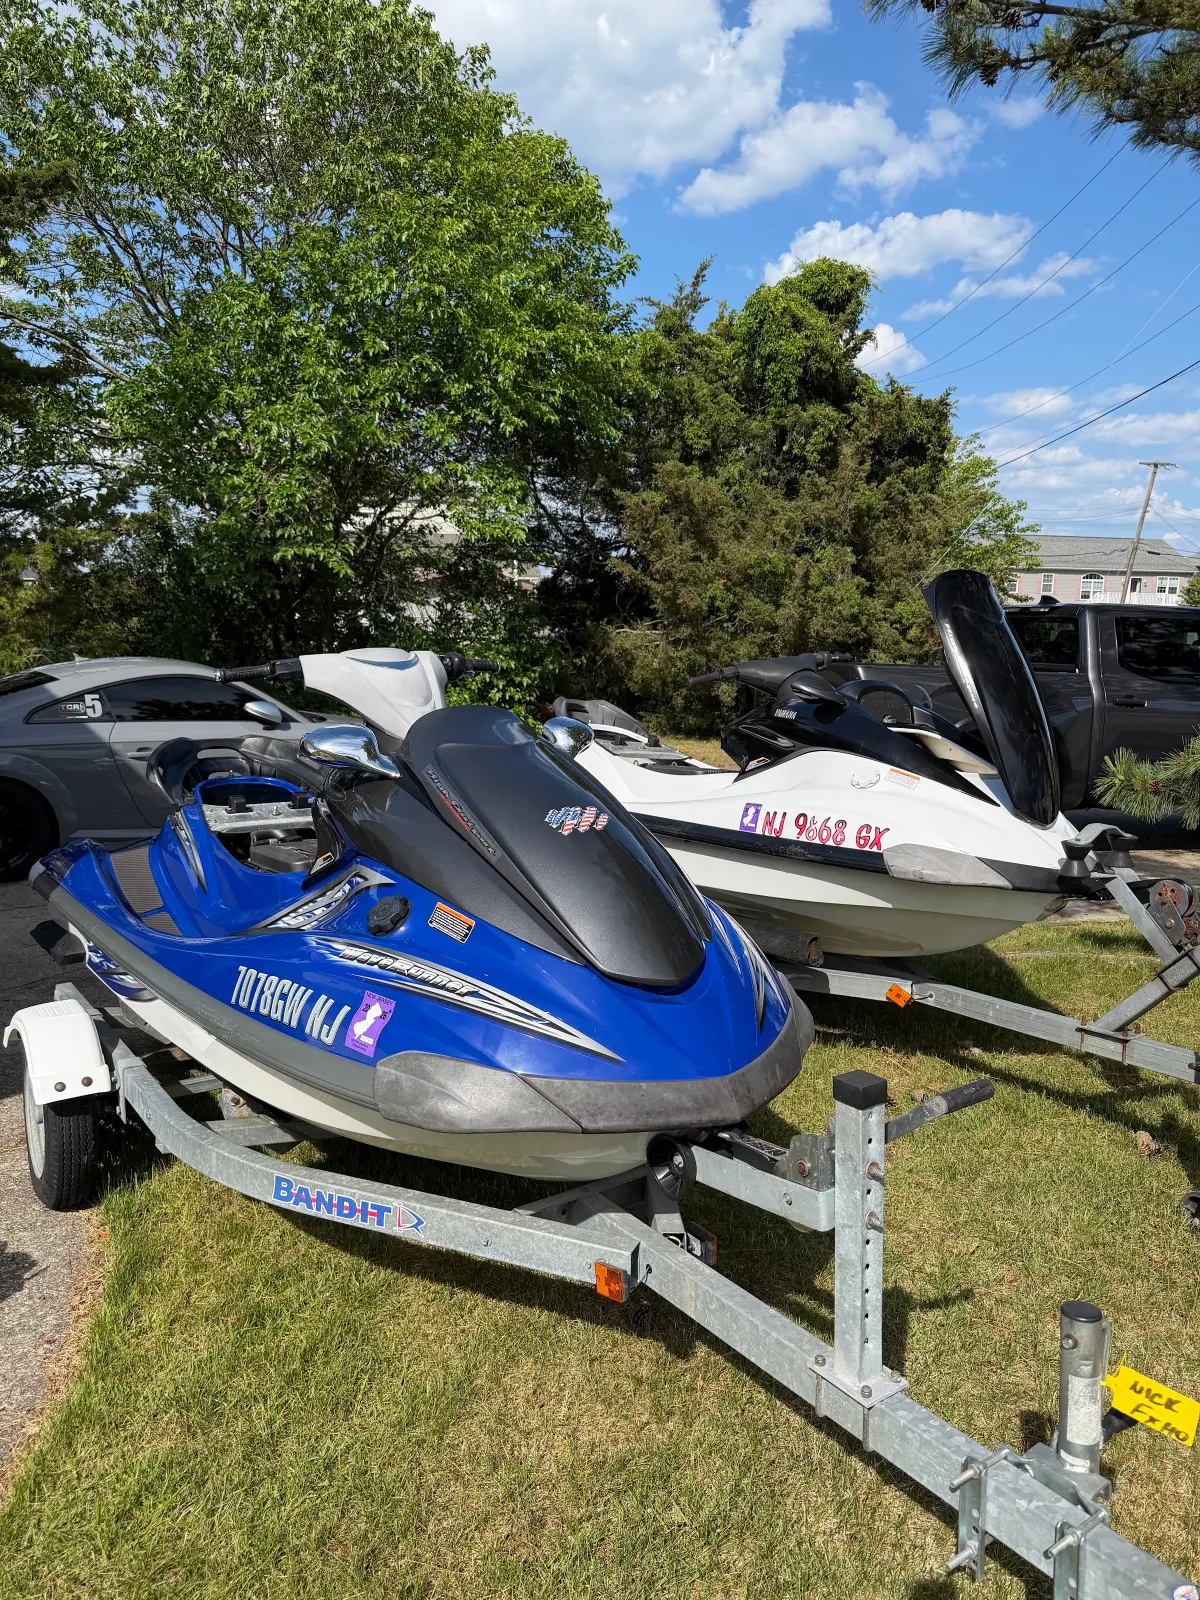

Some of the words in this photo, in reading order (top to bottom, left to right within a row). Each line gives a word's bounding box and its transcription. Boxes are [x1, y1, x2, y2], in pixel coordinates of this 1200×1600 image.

[84, 694, 103, 718] 5
[774, 708, 798, 720] YAMAHA
[762, 811, 787, 837] NJ
[855, 823, 890, 851] GX
[339, 946, 480, 998] WaveRunner
[230, 965, 314, 1029] 1078GW
[304, 994, 352, 1046] NJ
[366, 991, 377, 1000] NEW
[376, 996, 394, 1006] JERSEY
[272, 1174, 393, 1228] BANDIT
